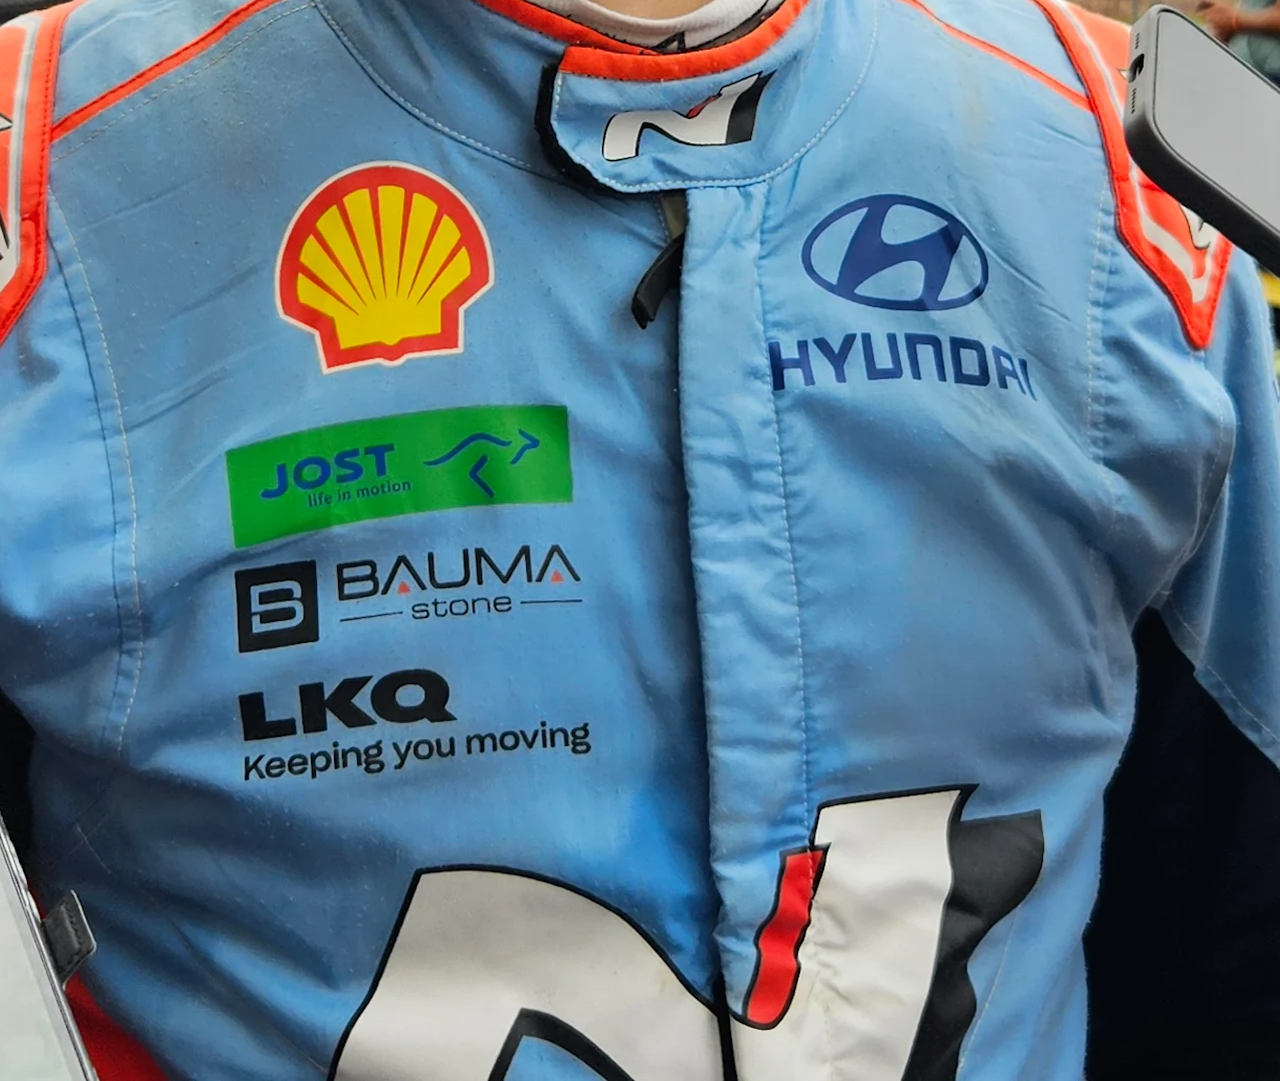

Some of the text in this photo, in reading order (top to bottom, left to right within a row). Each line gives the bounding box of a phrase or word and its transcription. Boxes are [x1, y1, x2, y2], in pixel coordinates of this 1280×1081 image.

[767, 332, 1037, 401] HYUNDAI
[260, 443, 396, 499] JOST
[307, 478, 412, 508] life in motion
[336, 543, 581, 601] BAUMA
[411, 595, 512, 619] stone
[238, 668, 458, 742] LKQ
[243, 720, 592, 781] Keeping you moving
